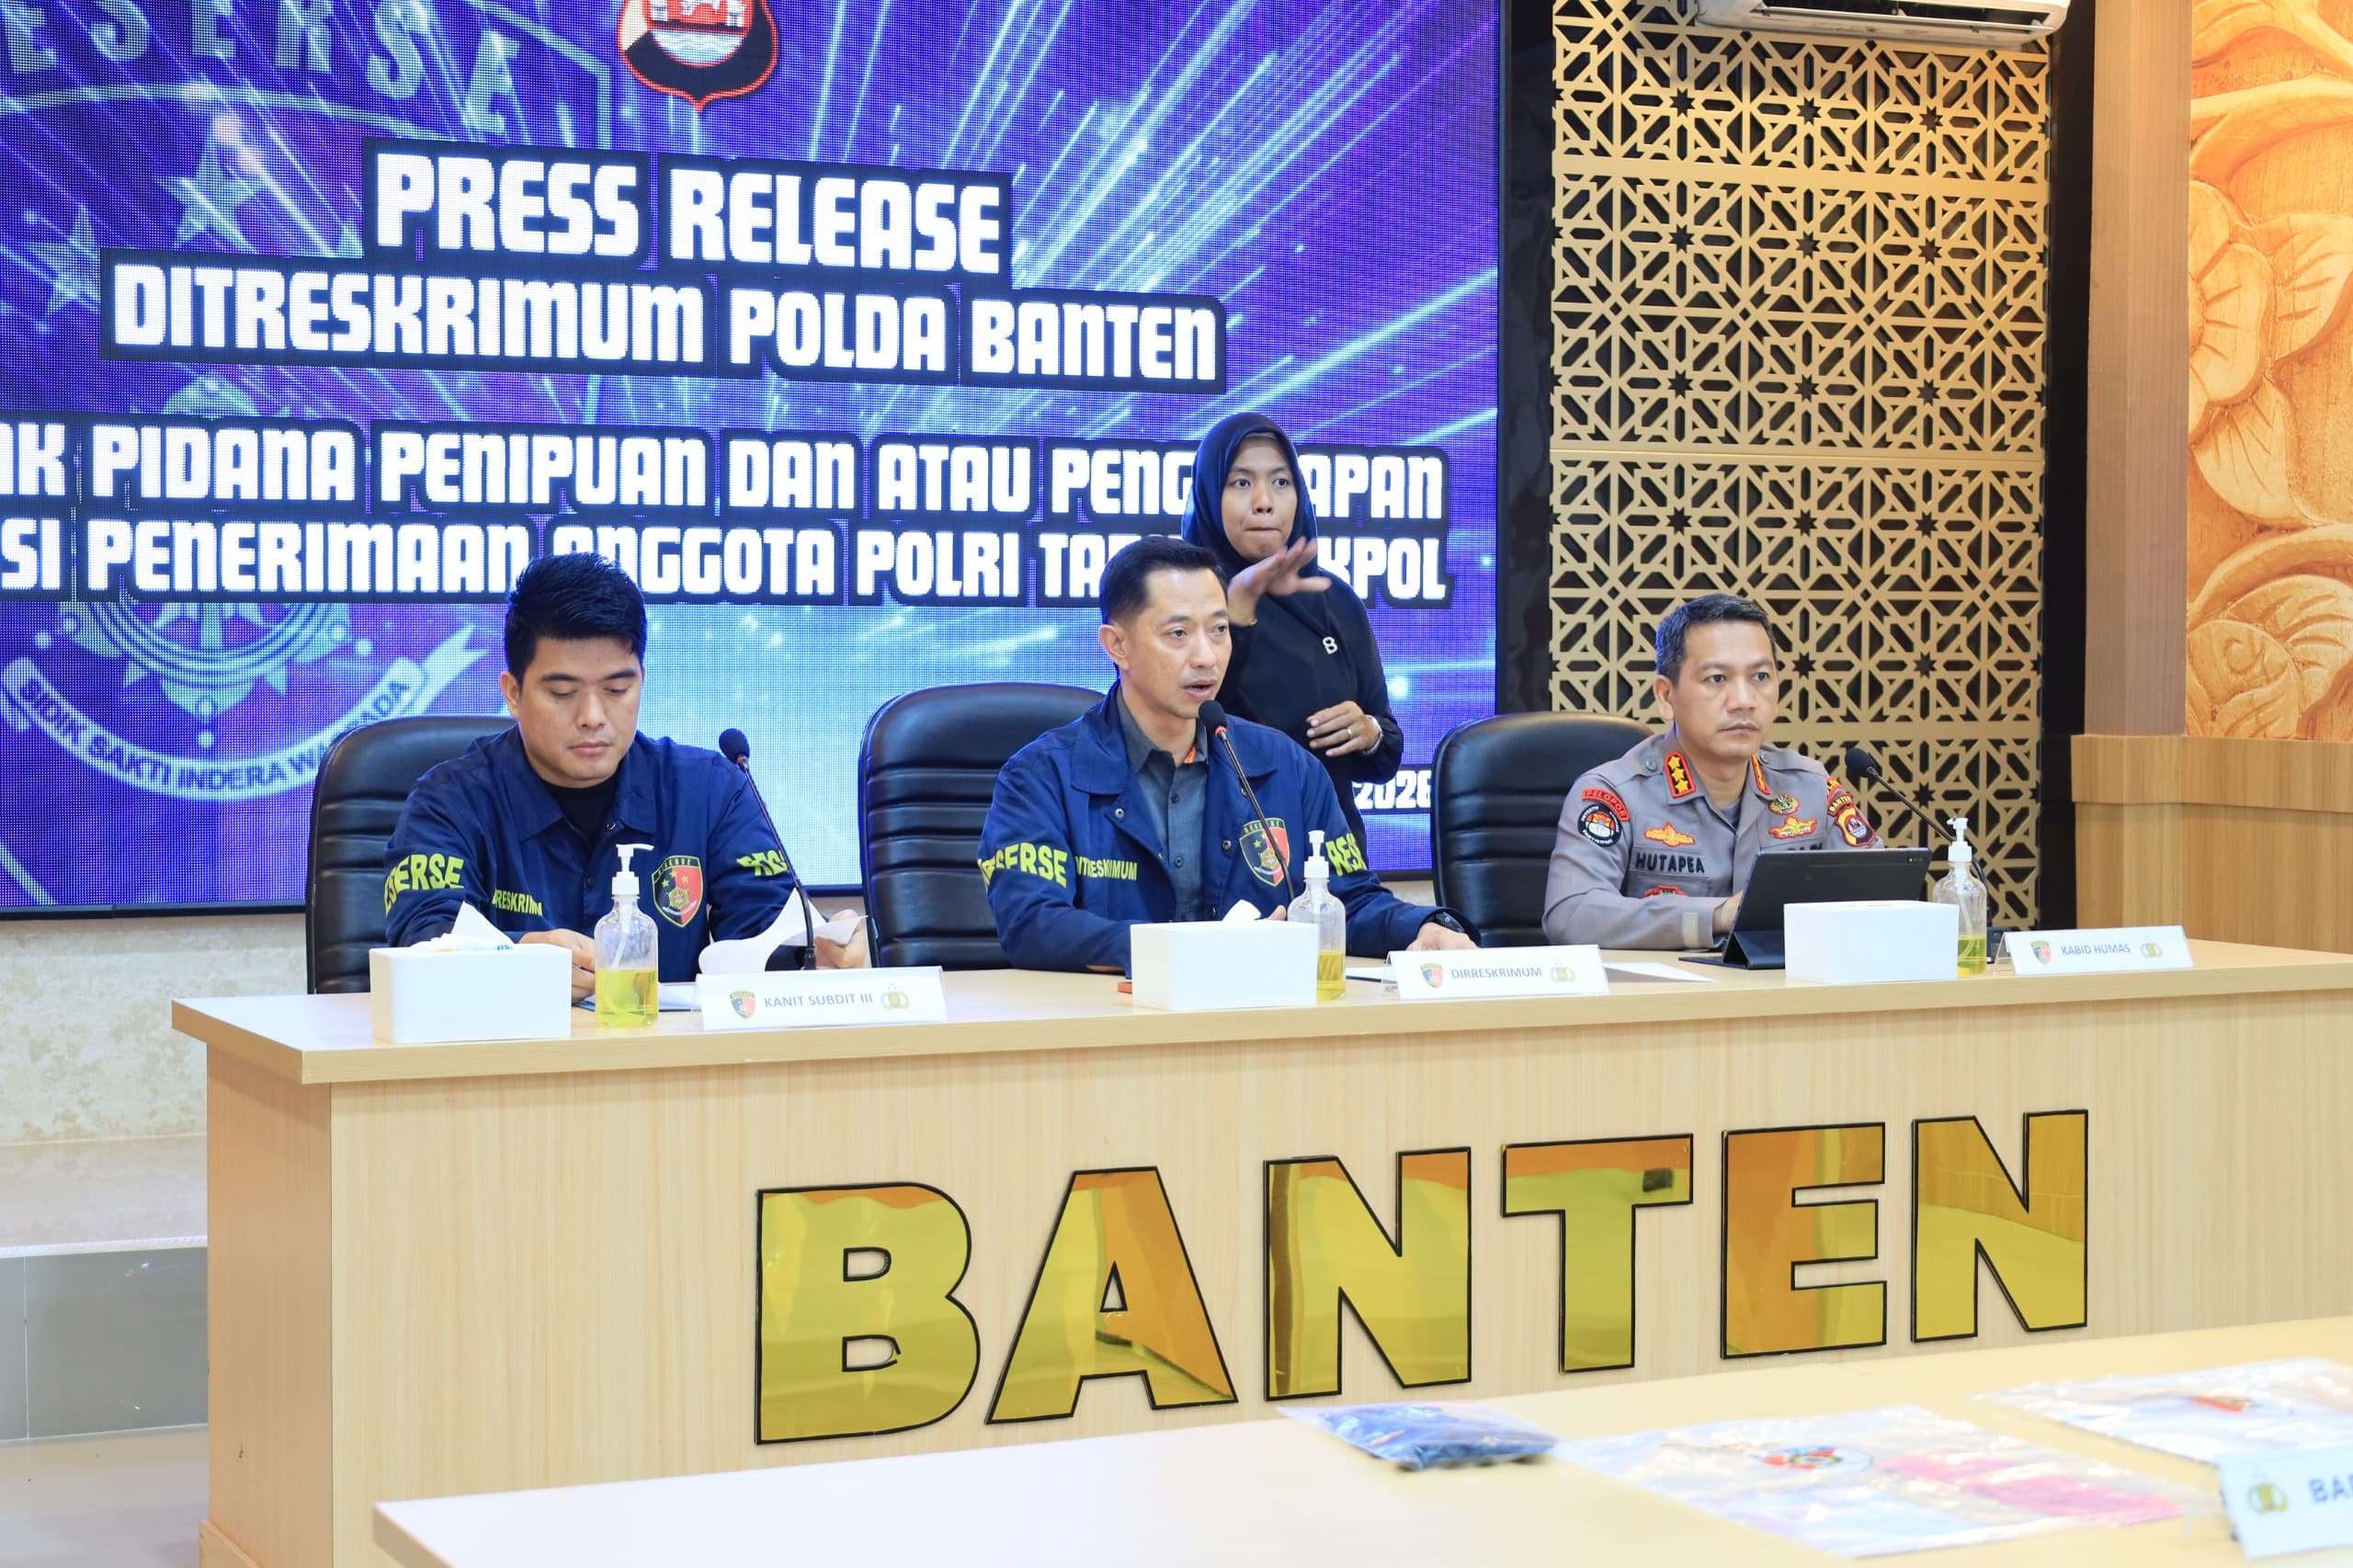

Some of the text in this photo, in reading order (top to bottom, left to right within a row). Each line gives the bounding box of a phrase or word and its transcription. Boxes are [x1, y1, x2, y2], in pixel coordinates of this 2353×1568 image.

[376, 152, 1002, 274] PRESS RELEASE
[114, 263, 1217, 381] DITRESKRIMUM POLDA BANTEN
[92, 424, 356, 501] PIDANA
[380, 430, 707, 506] PENIPUAN
[728, 438, 856, 509] DAN
[877, 443, 1031, 513] ATAU
[1051, 447, 1444, 520] PENGAPAN
[86, 517, 530, 594] PENERIMAAN
[856, 528, 1020, 597] POLRI
[1317, 536, 1447, 600] KPOL
[87, 734, 172, 788] SAKTI
[176, 764, 288, 793] INDERA
[1634, 851, 1705, 874] HUTAPEA
[1450, 967, 1543, 979] DIRRESKRIMUM
[2061, 943, 2131, 957] KABID HUMAS
[764, 995, 804, 1008] KANIT
[808, 994, 856, 1006] SUBDIT
[755, 1108, 2088, 1446] BANTEN
